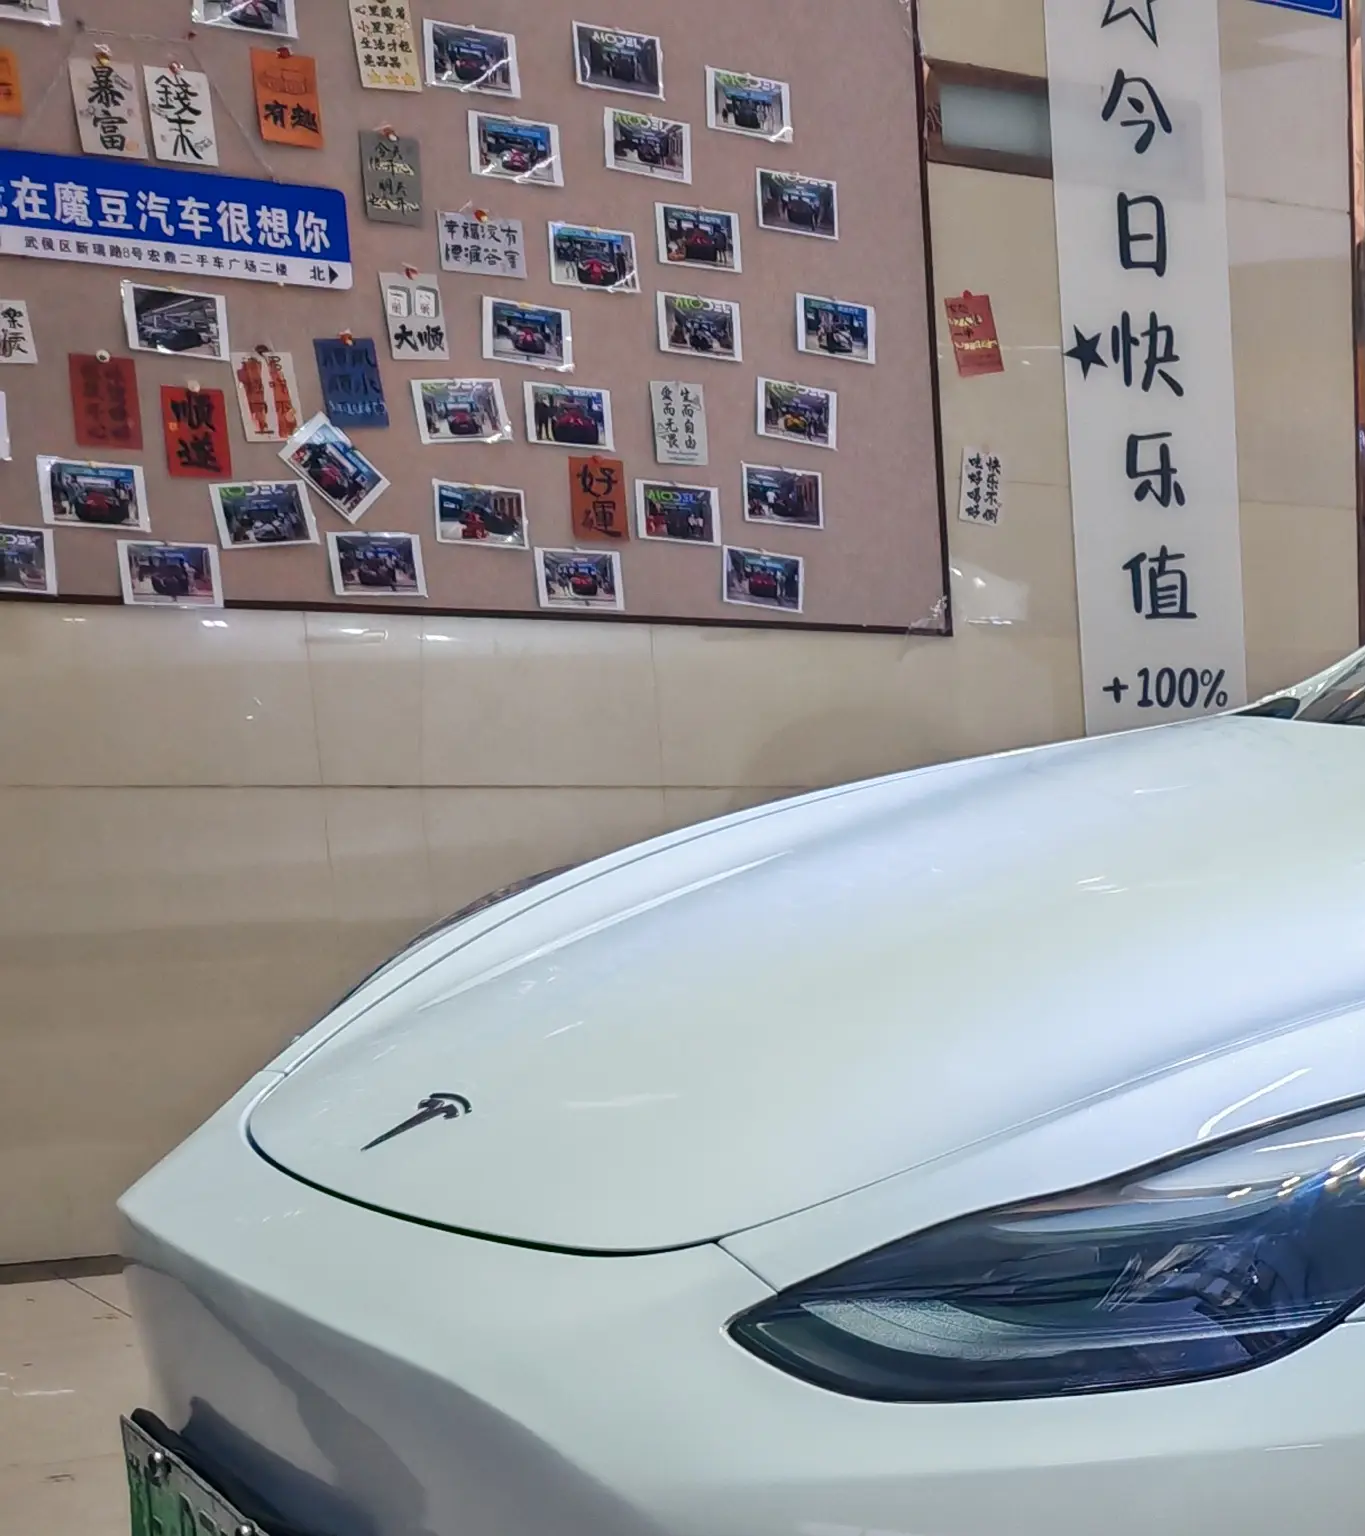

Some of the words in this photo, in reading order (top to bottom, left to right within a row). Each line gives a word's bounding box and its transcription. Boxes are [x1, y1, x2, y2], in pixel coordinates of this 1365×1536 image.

[88, 65, 127, 151] 暴富
[310, 266, 325, 281] 北
[1101, 68, 1197, 618] 今日快乐值
[680, 386, 697, 450] 生而自由
[1102, 666, 1228, 710] +100%
